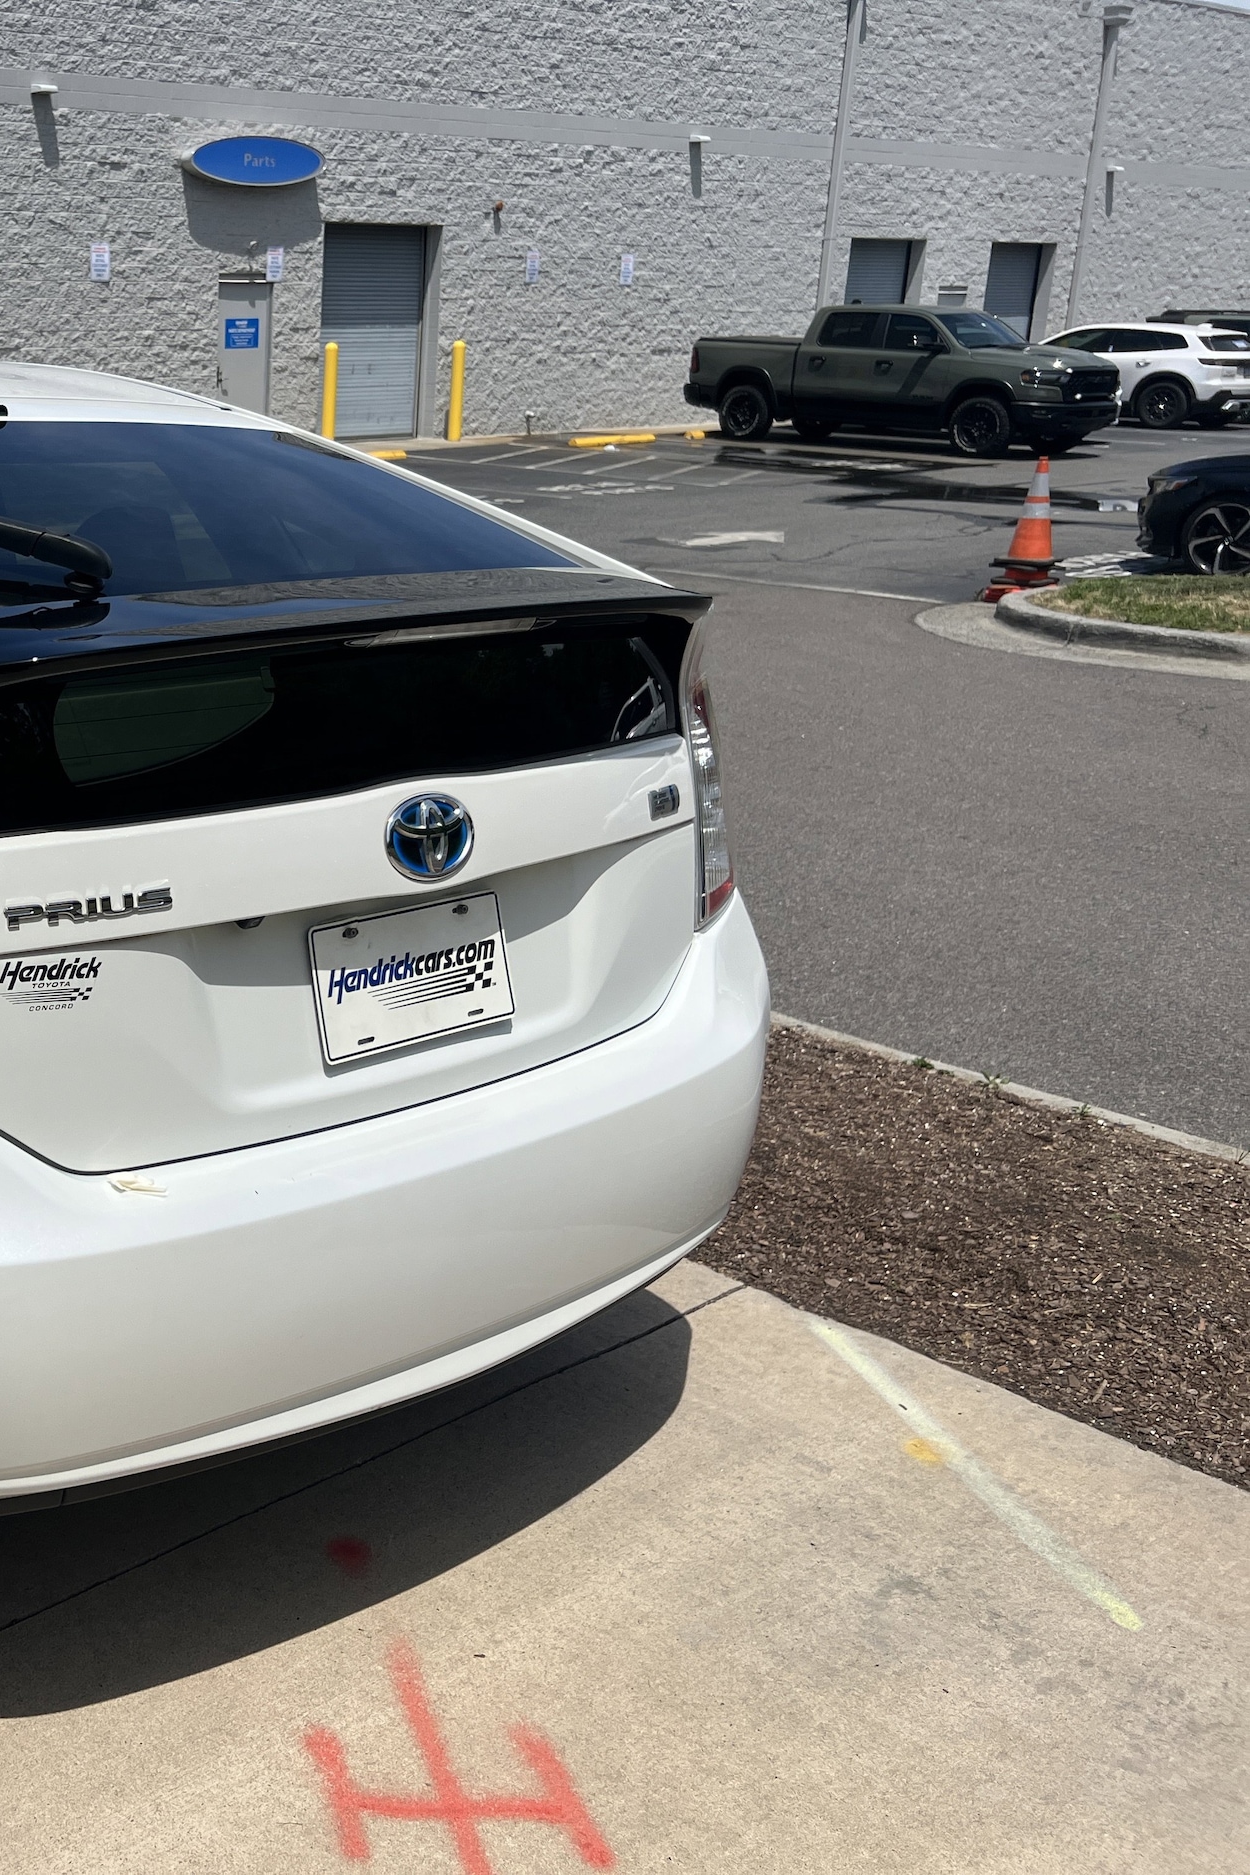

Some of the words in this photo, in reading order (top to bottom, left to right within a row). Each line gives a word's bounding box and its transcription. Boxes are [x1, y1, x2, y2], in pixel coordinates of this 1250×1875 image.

[244, 154, 276, 167] Parts
[4, 887, 173, 931] PRIUS
[0, 957, 102, 990] Hendrick
[328, 939, 495, 1004] Hendrickcars.com
[32, 981, 71, 989] TOYOTA
[29, 1003, 74, 1012] CONCORD
